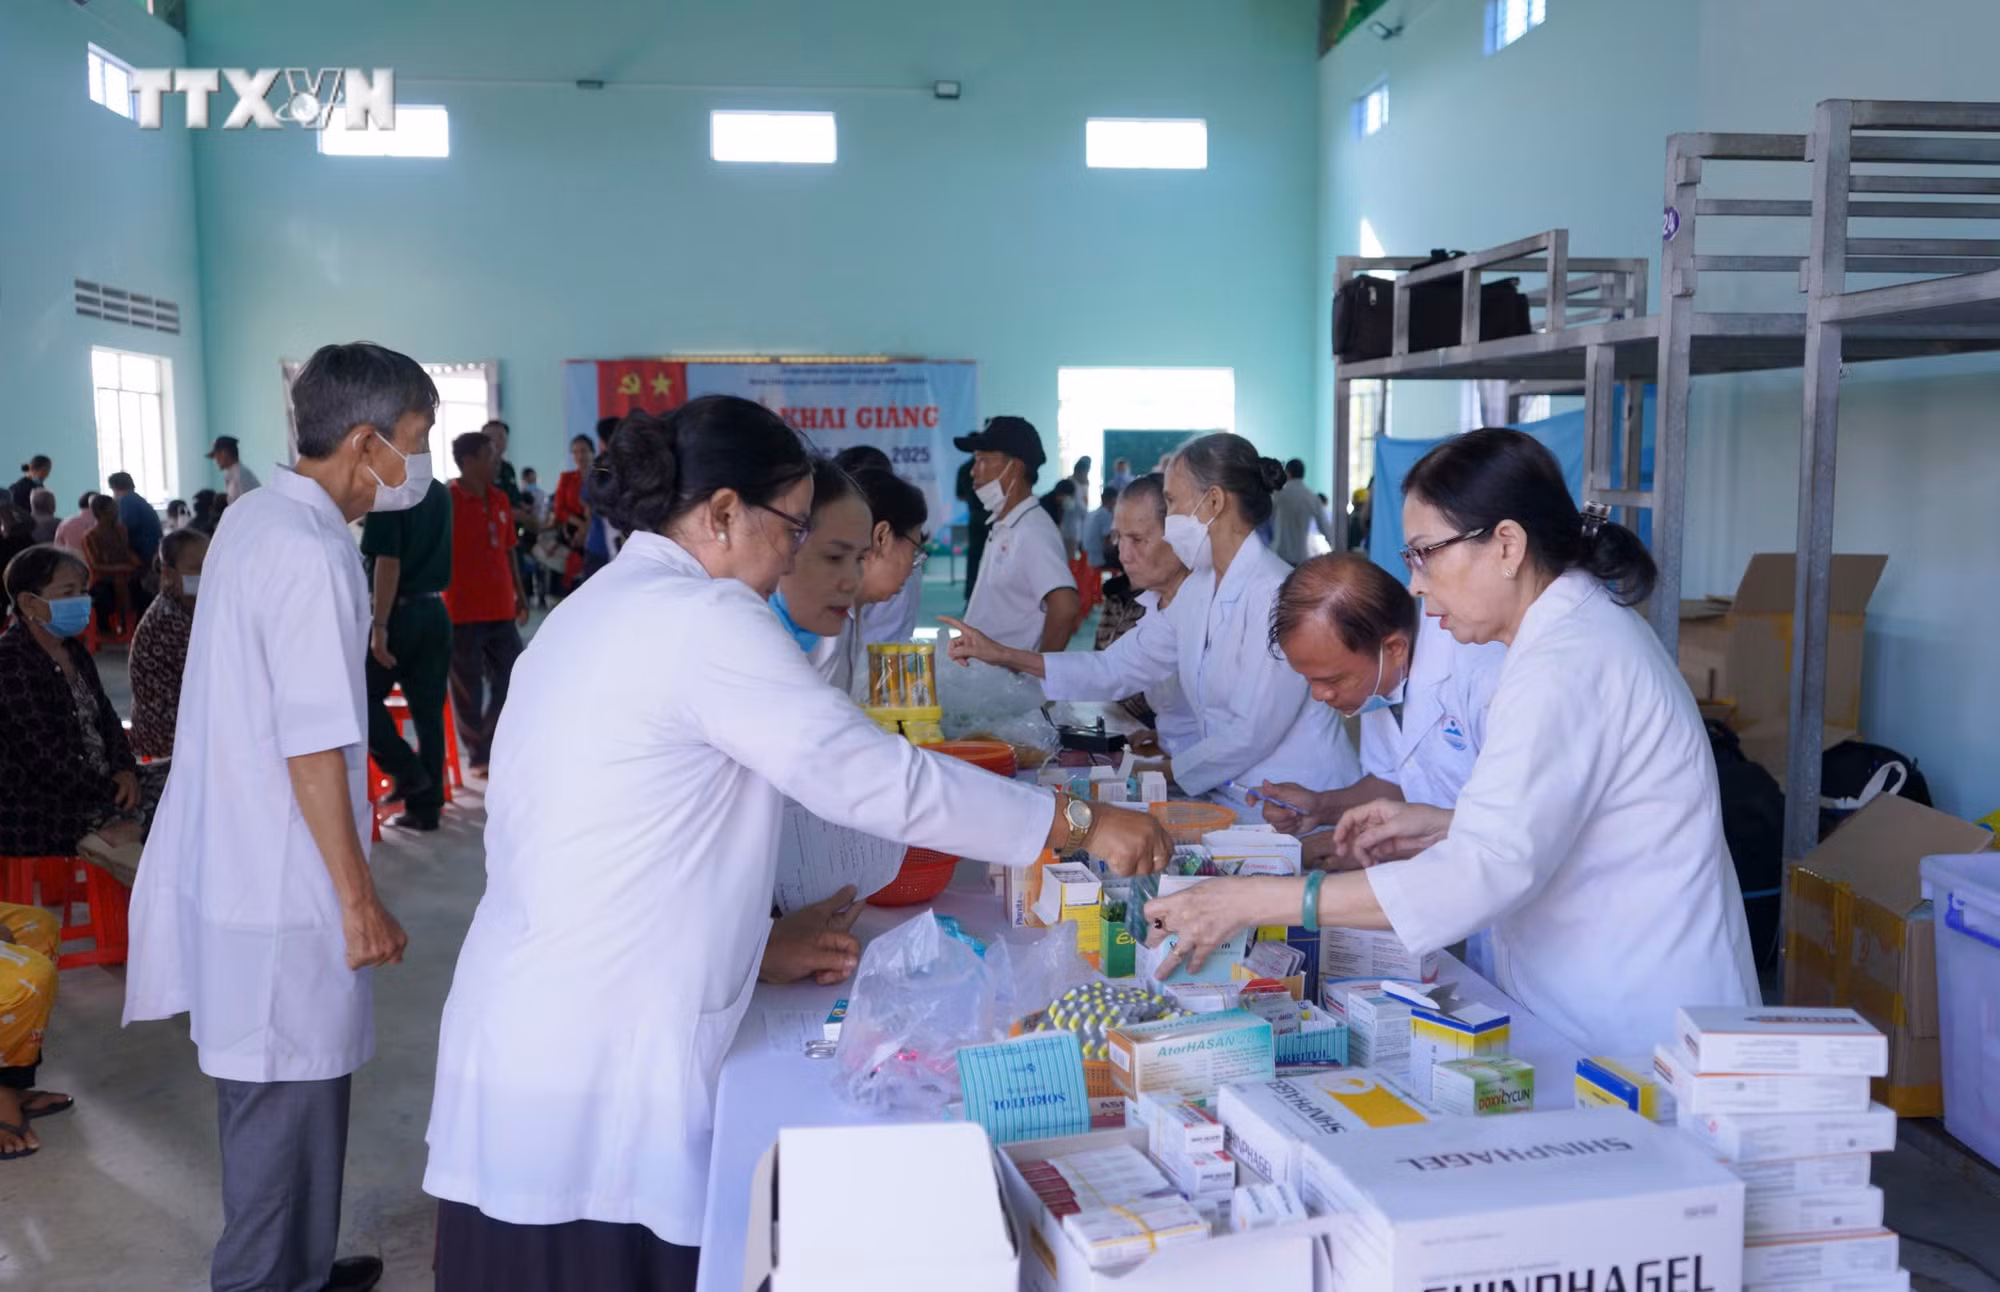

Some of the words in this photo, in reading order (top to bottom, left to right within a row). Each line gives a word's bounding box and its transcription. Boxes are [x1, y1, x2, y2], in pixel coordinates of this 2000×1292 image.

[779, 407, 846, 429] KHAI
[892, 447, 931, 463] 2025
[1157, 1036, 1235, 1057] AtorHASAN
[1396, 1137, 1633, 1171] SHINPHAGEL
